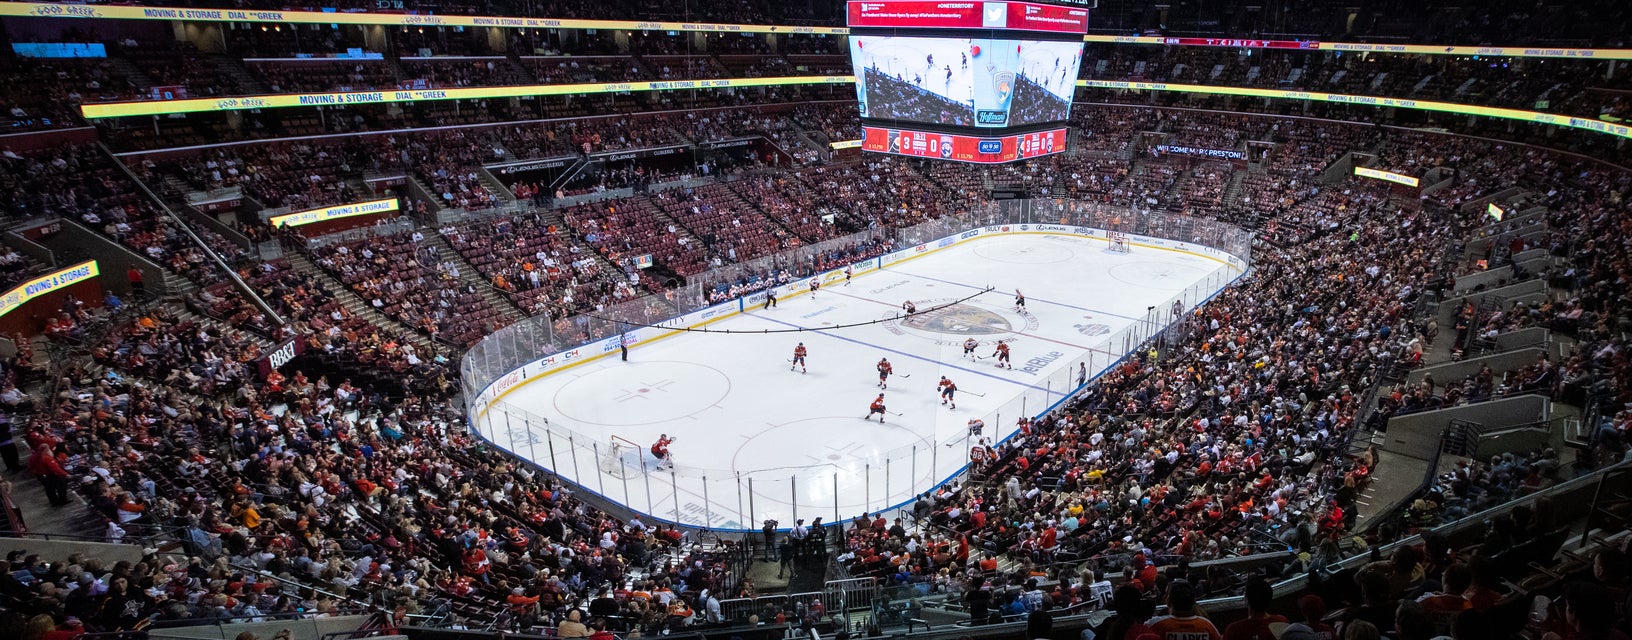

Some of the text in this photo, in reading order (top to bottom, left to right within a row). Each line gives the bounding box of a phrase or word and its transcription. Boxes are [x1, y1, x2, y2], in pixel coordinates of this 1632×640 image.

[144, 9, 176, 18] MOVING
[186, 10, 222, 19] STORAGE
[228, 11, 247, 19] DIAL
[300, 96, 335, 104] MOVING
[346, 93, 383, 103] STORAGE
[395, 92, 414, 100] DIAL
[904, 137, 910, 150] 3
[931, 139, 937, 152] 0
[1026, 140, 1030, 152] 3
[1041, 138, 1046, 150] 0
[326, 207, 352, 217] MOVING
[361, 202, 390, 212] STORAGE
[961, 230, 978, 239] GEICO
[24, 266, 90, 296] MOVING & STORAGE
[269, 340, 296, 369] BB&T
[541, 356, 555, 366] CH
[565, 349, 579, 359] CH
[498, 370, 519, 392] Coca-Cola
